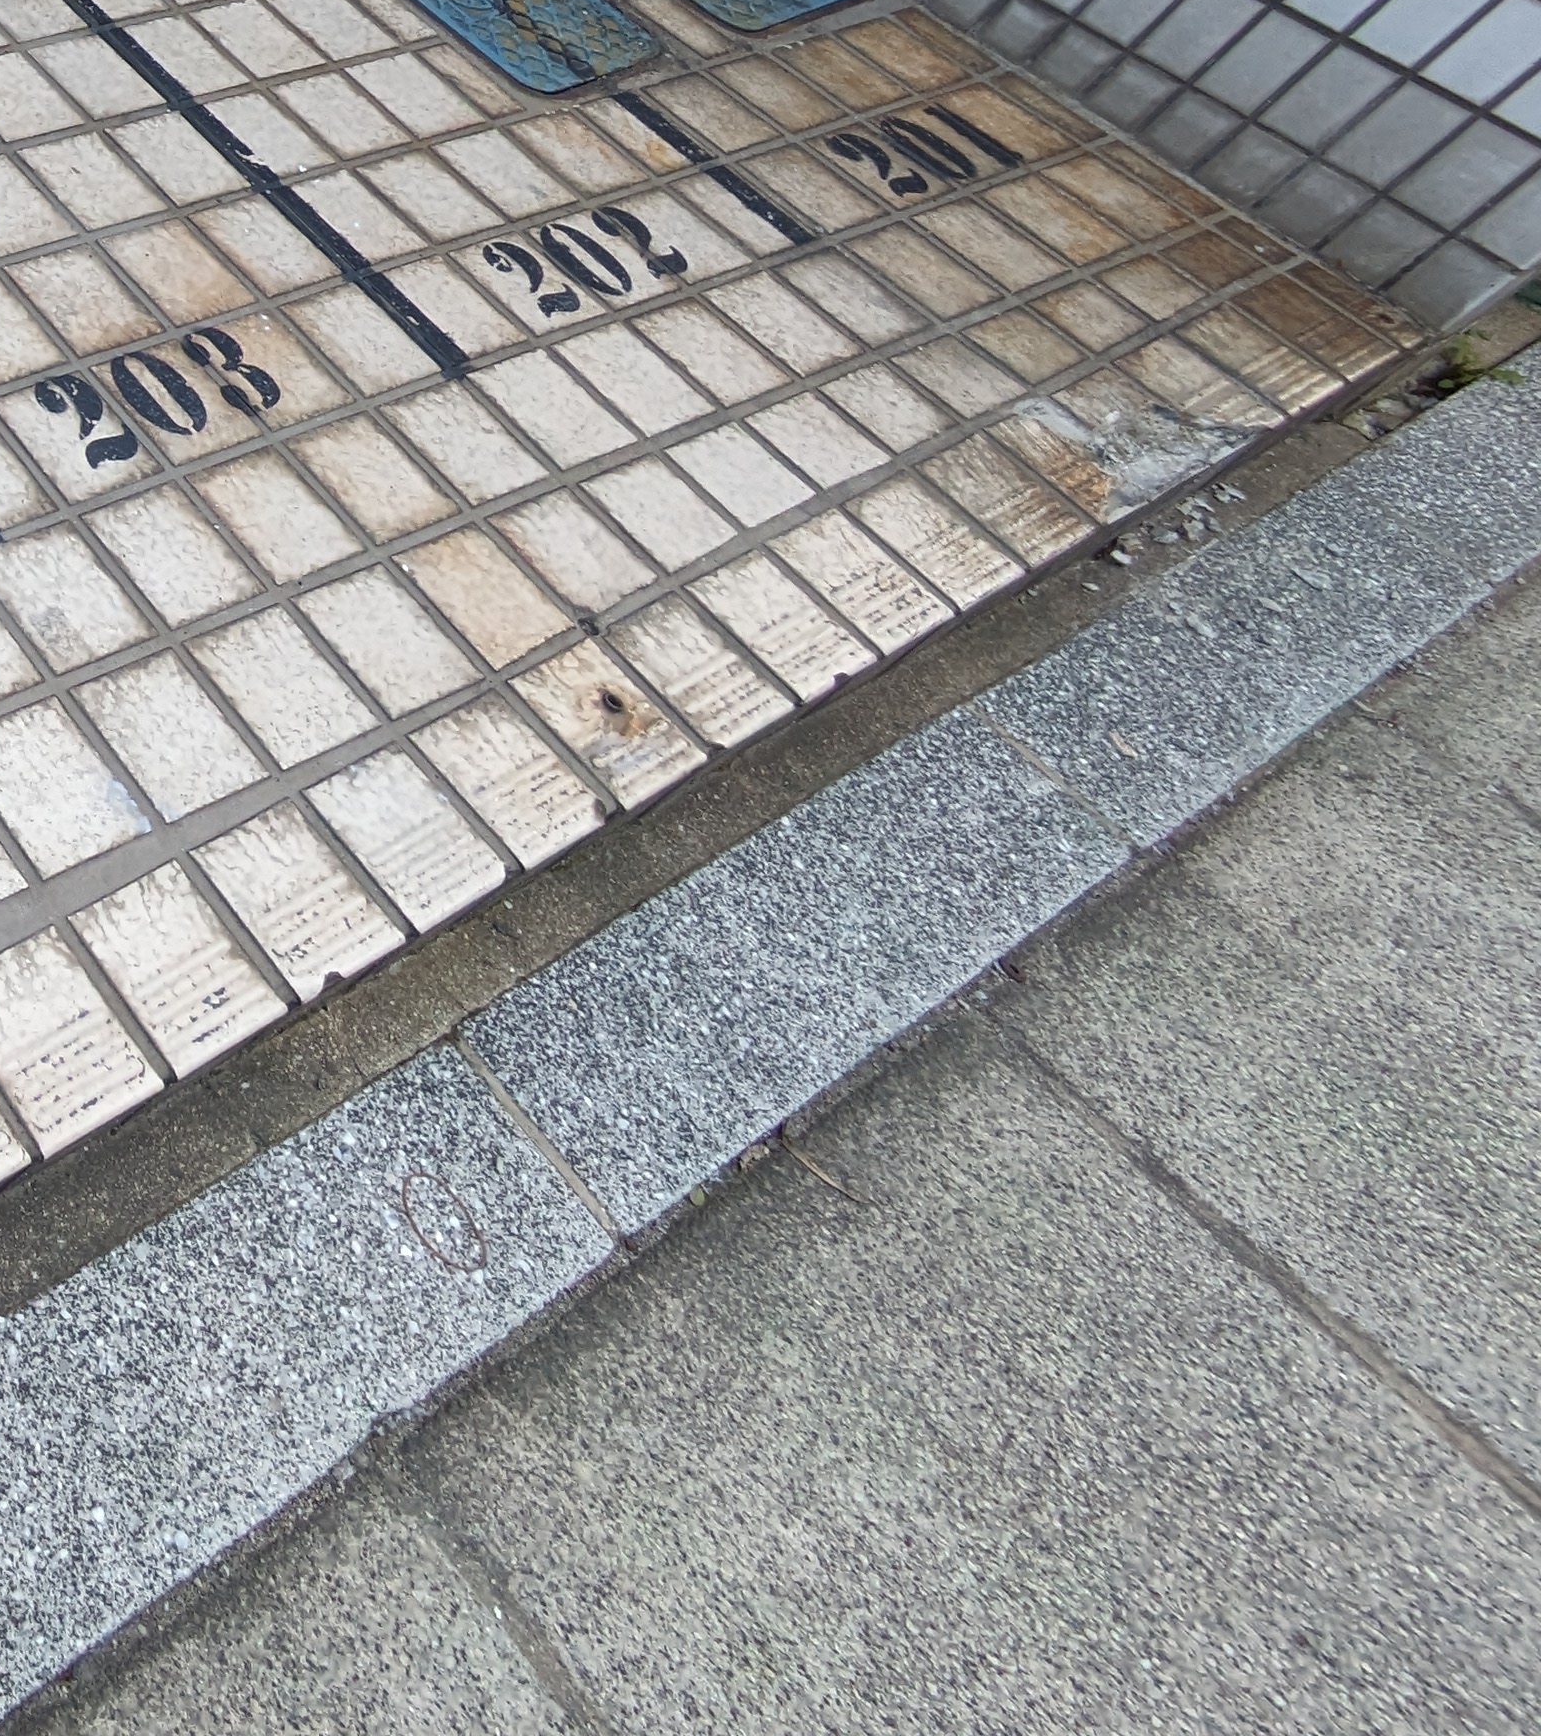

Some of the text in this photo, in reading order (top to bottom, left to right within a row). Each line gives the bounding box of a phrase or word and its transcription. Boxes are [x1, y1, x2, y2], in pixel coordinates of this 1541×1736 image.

[825, 102, 1024, 198] 201
[482, 206, 689, 318] 202
[34, 326, 282, 470] 203
